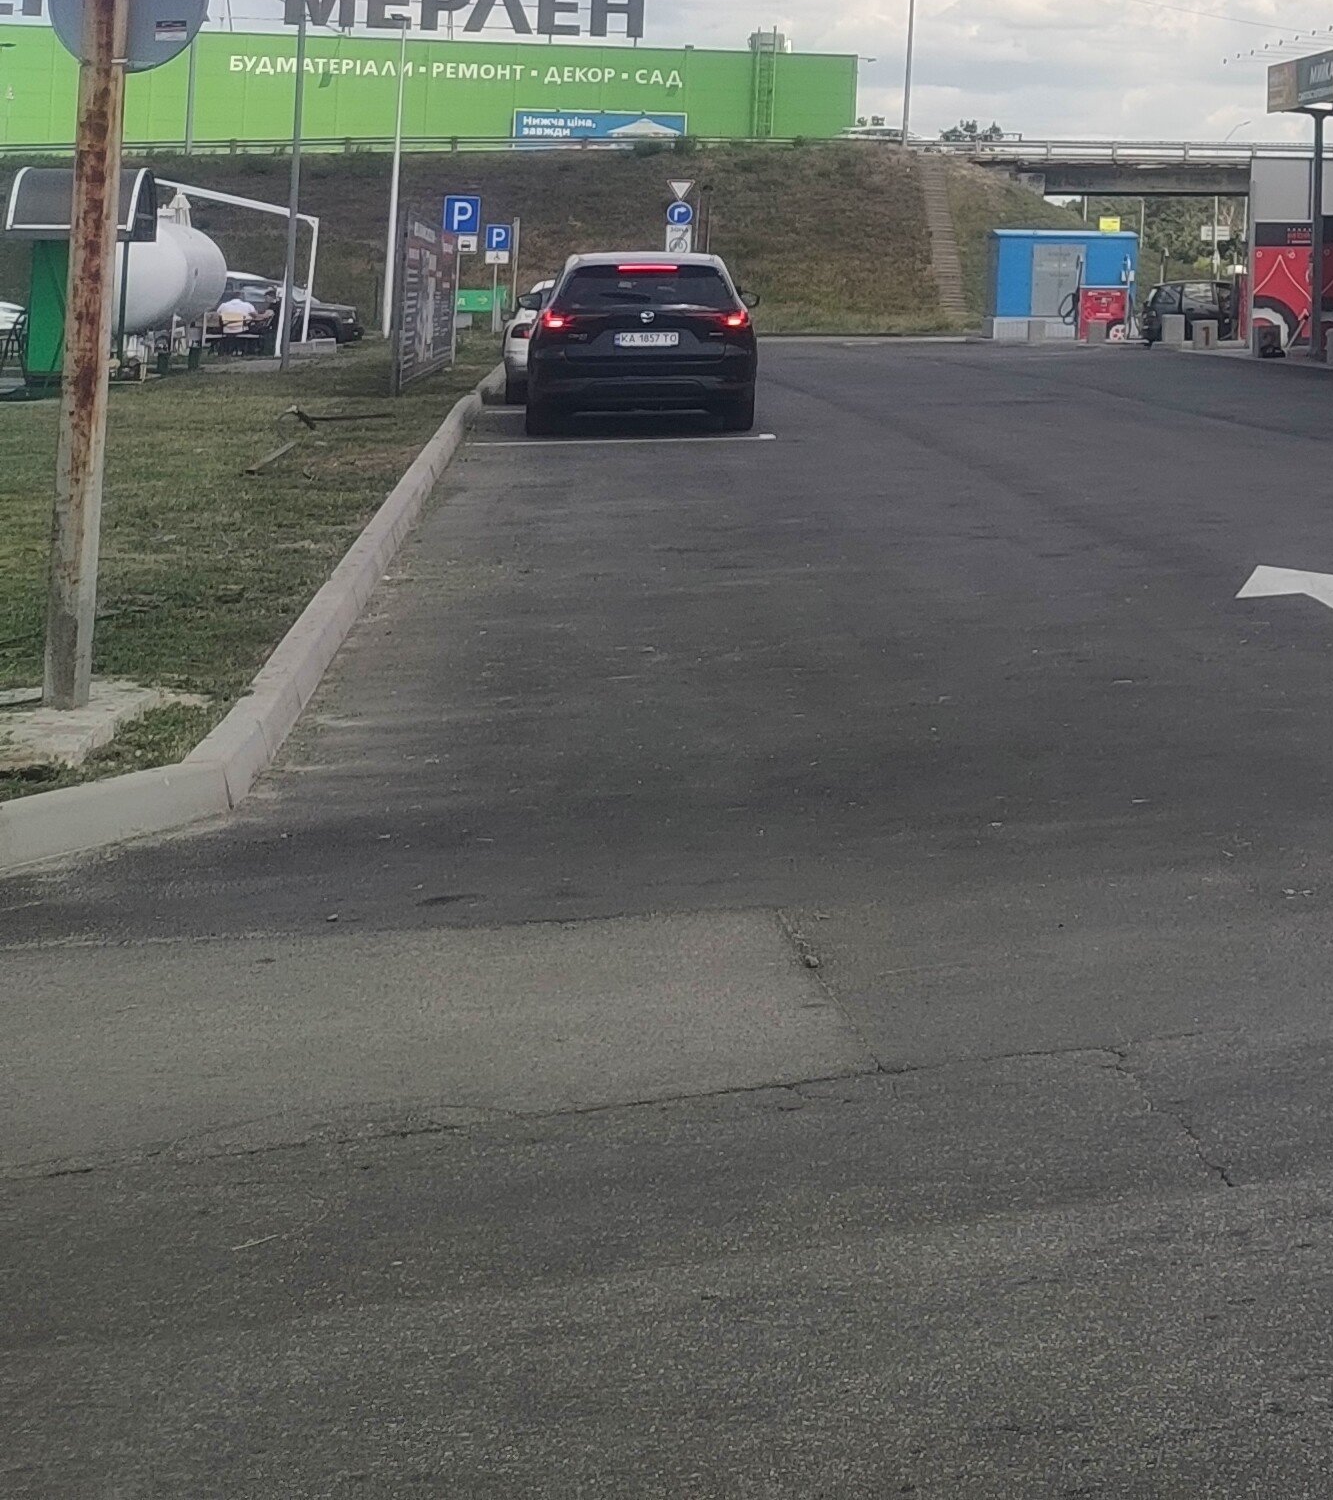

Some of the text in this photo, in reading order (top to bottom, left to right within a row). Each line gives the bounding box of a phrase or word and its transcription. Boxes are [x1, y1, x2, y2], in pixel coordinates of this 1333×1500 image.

[229, 55, 683, 88] БУДМАТЕРІАЛИ РЕМОНТ ДЕКОР САД
[522, 115, 596, 130] Нижча ціна,
[522, 127, 571, 137] завжди
[453, 202, 472, 230] P
[492, 228, 506, 248] P
[621, 333, 677, 343] KA 1857 TO
[1201, 326, 1210, 346] 1
